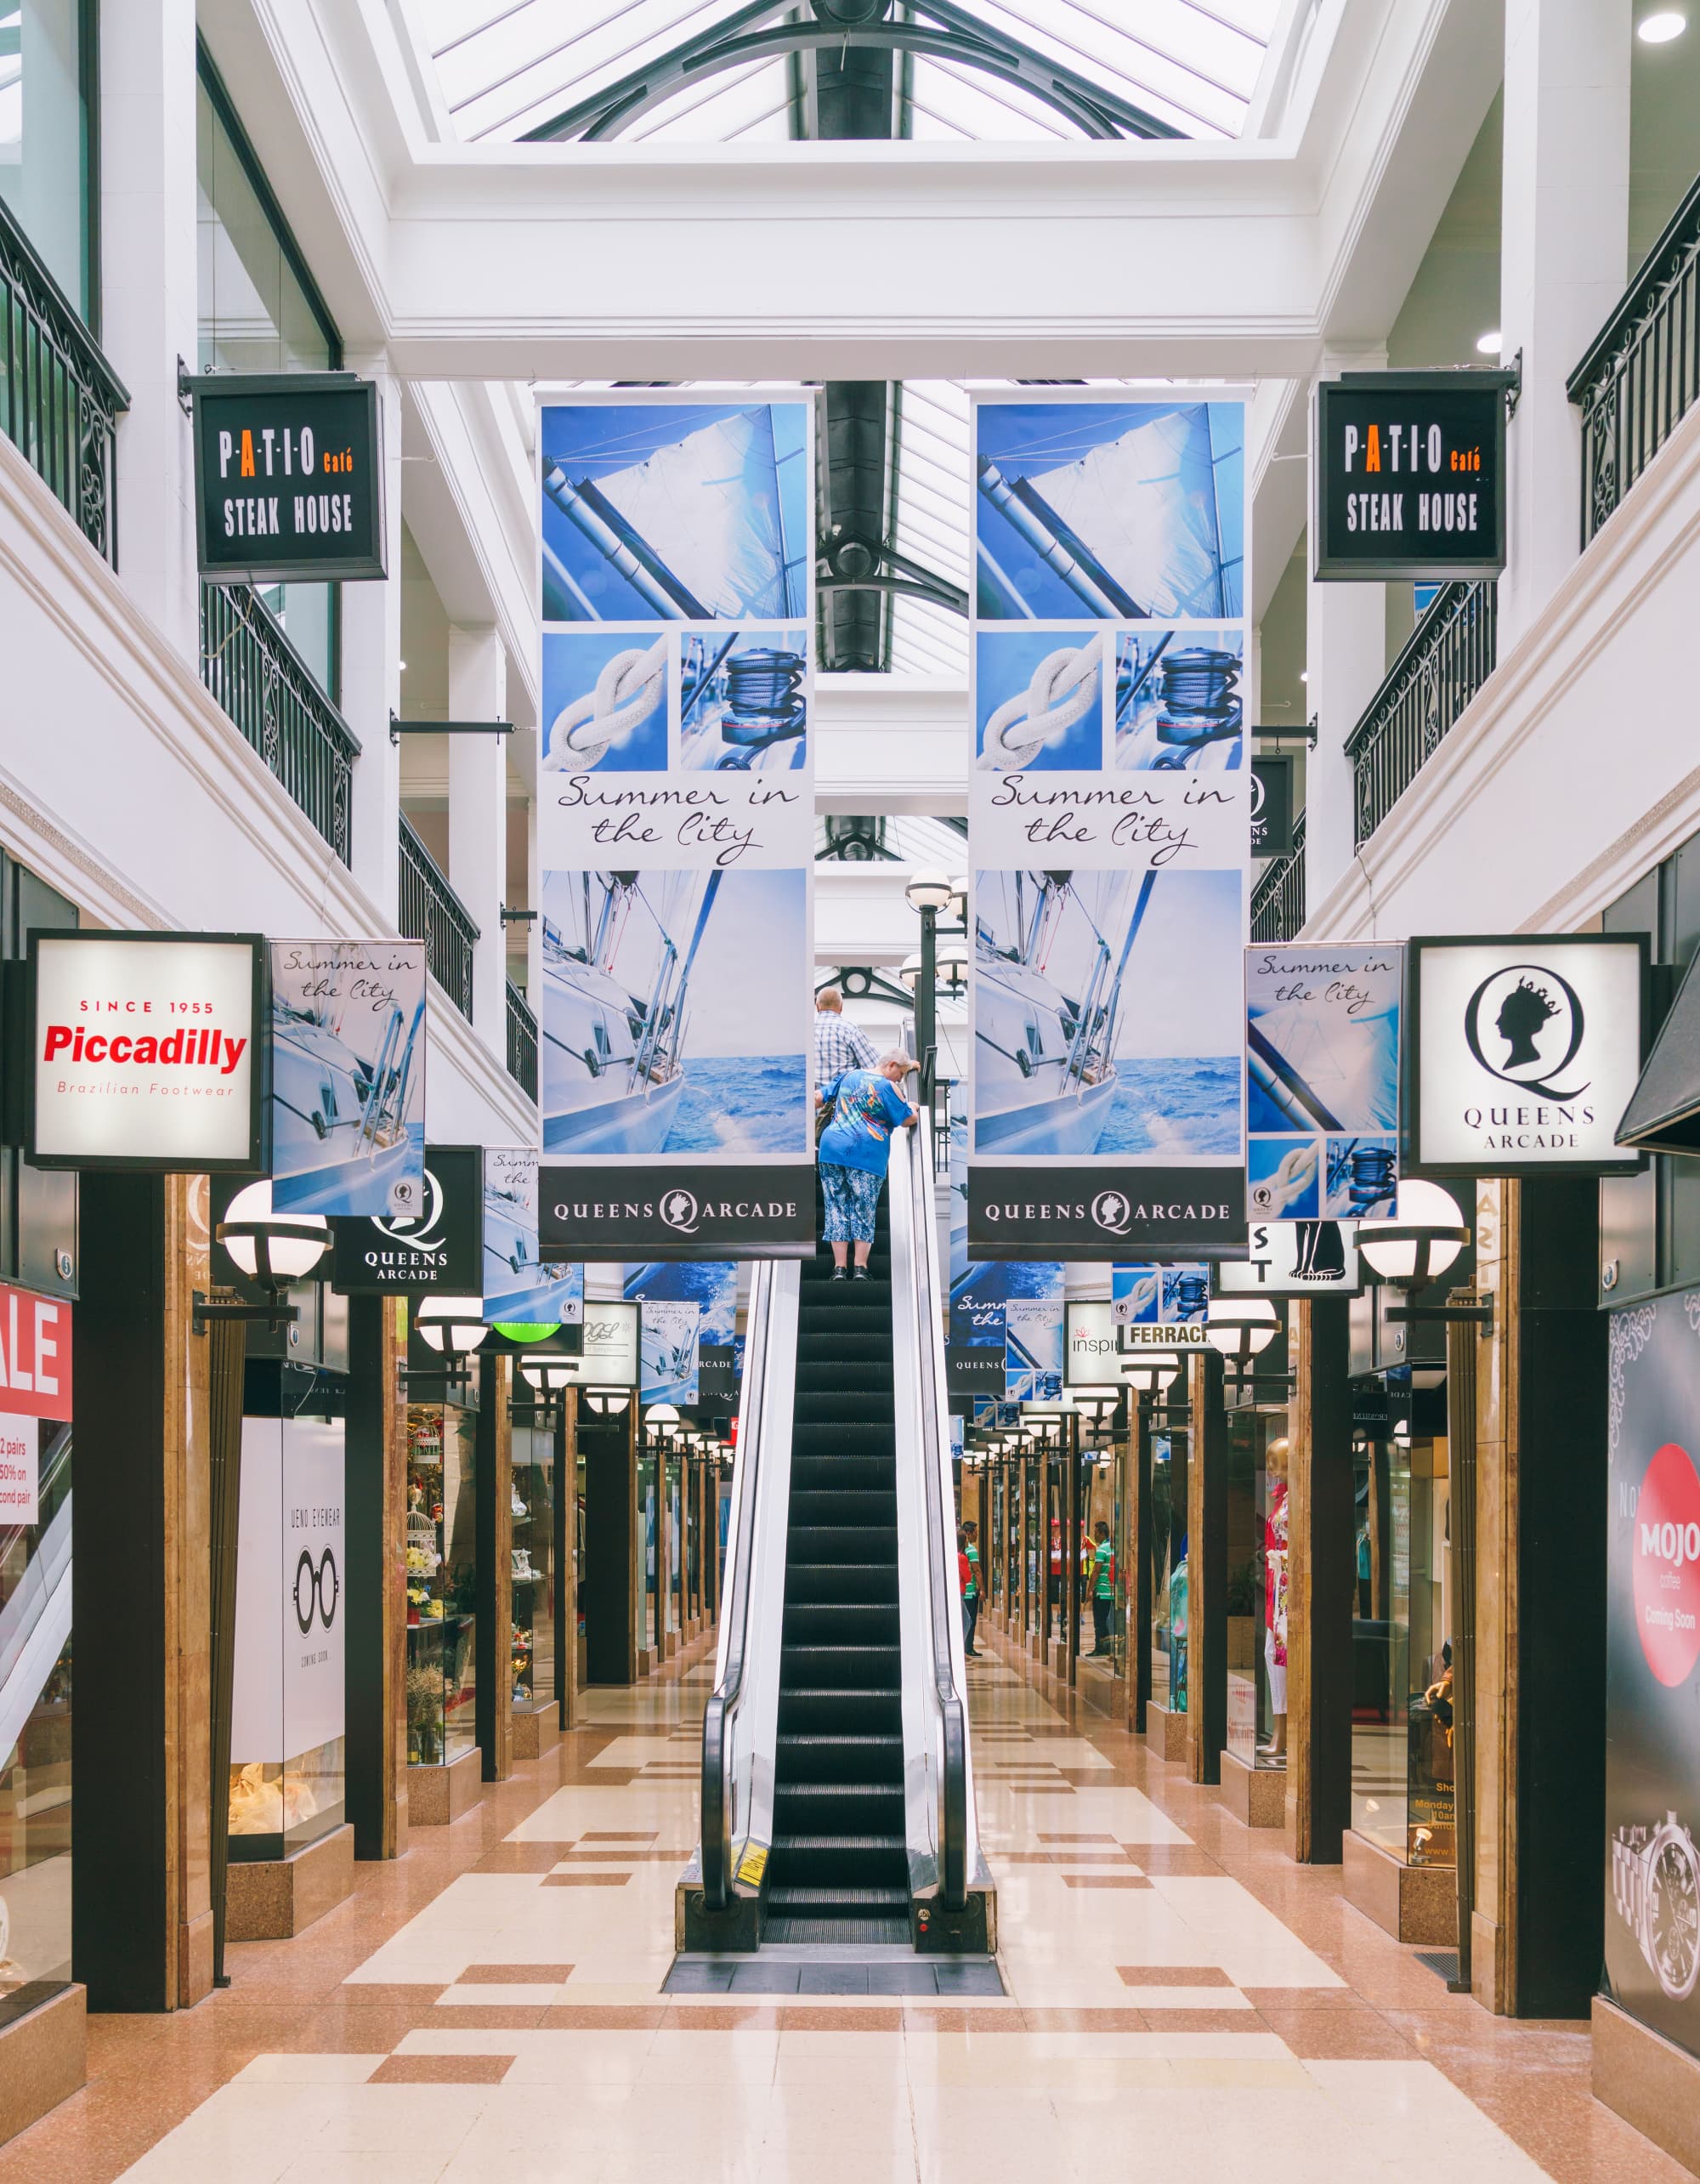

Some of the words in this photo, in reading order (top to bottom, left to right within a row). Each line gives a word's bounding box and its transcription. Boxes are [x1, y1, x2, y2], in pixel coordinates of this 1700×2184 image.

[323, 446, 353, 474] Café
[1450, 445, 1481, 472] Café
[224, 497, 280, 536] STEAK
[294, 494, 352, 534] HOUSE
[1346, 493, 1403, 531] STEAK
[1419, 492, 1477, 531] HOUSE
[558, 775, 729, 806] Summer
[749, 778, 800, 805] in
[991, 775, 1164, 806] Summer
[1183, 778, 1235, 805] in
[591, 813, 663, 843] the
[677, 811, 764, 866] City
[1024, 812, 1097, 842] the
[1112, 811, 1198, 866] City
[283, 950, 381, 970] Summer
[388, 954, 417, 971] in
[1257, 955, 1357, 974] Summer
[1363, 956, 1394, 972] in
[301, 979, 342, 997] the
[349, 979, 400, 1012] City
[1274, 982, 1316, 1001] the
[1324, 981, 1374, 1014] City
[80, 1000, 152, 1013] SINCE
[169, 1001, 213, 1014] 1955
[43, 1025, 247, 1075] Piccadilly
[57, 1081, 139, 1095] Brazilian
[150, 1082, 234, 1096] Footwear
[1464, 1106, 1595, 1129] QUEENS
[1484, 1134, 1578, 1149] ARCADE
[504, 1172, 531, 1184] the
[554, 1203, 654, 1221] QUEENS
[701, 1202, 797, 1218] ARCADE
[985, 1204, 1085, 1221] QUEENS
[1134, 1205, 1230, 1219] ARCADE
[365, 1251, 448, 1267] QUEENS
[377, 1269, 438, 1280] ARCADE
[972, 1312, 1004, 1326] the
[0, 1437, 5, 1455] 2
[7, 1437, 26, 1459] pairs
[0, 1464, 16, 1480] 50%
[18, 1469, 26, 1481] on
[18, 1489, 31, 1507] pair
[292, 1509, 309, 1528] UENO
[313, 1508, 340, 1528] EYEWEAR
[1640, 1522, 1700, 1567] MOJO
[1659, 1571, 1681, 1590] coffee
[1646, 1605, 1674, 1631] Coming
[1674, 1608, 1696, 1630] Soon
[301, 1653, 316, 1669] COMING
[1414, 1799, 1454, 1811] Monday
